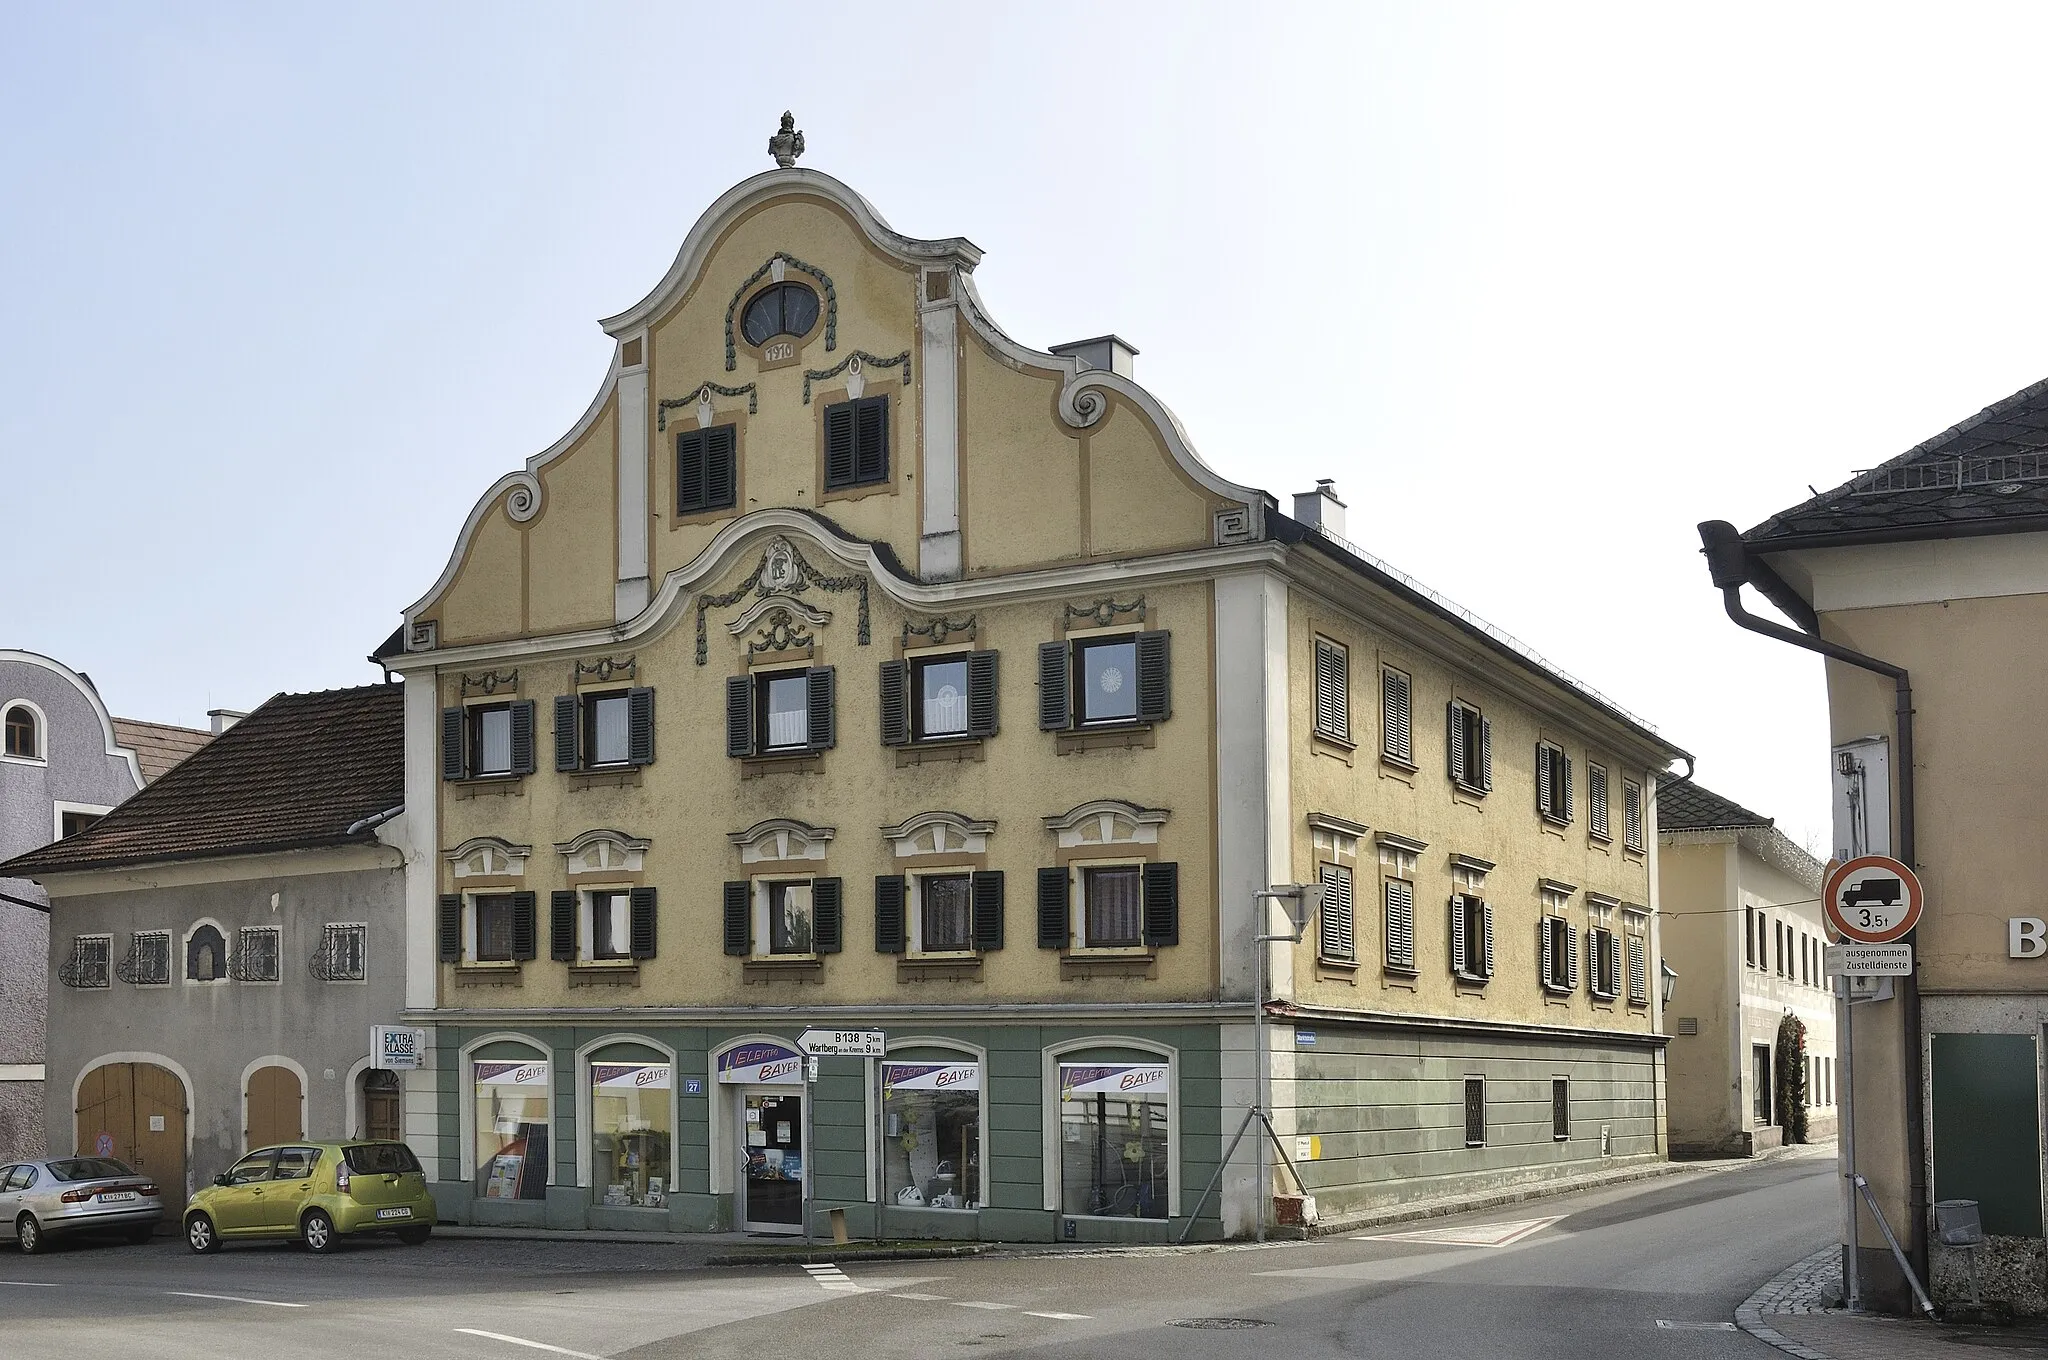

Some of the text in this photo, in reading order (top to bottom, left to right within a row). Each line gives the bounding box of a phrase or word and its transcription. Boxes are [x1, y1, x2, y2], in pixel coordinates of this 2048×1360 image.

[767, 344, 792, 361] 1910
[2009, 917, 2047, 958] B
[1845, 949, 1908, 959] ausgenommen
[1846, 961, 1908, 970] Zustelldienste
[384, 1033, 414, 1044] EXTRA
[384, 1043, 414, 1054] KLASSE
[809, 1043, 838, 1055] Wartberg
[865, 1044, 871, 1053] 9
[394, 1056, 414, 1064] Siemens
[735, 1048, 779, 1065] ELEKTRO
[515, 1066, 546, 1082] BAYER
[635, 1069, 668, 1085] BAYER
[759, 1061, 799, 1080] BAYER
[891, 1066, 928, 1081] ELEKTRO
[936, 1069, 975, 1086] BAYER
[1070, 1068, 1112, 1083] ELEKTRO
[1120, 1070, 1163, 1089] BAYER
[688, 1083, 698, 1092] 27
